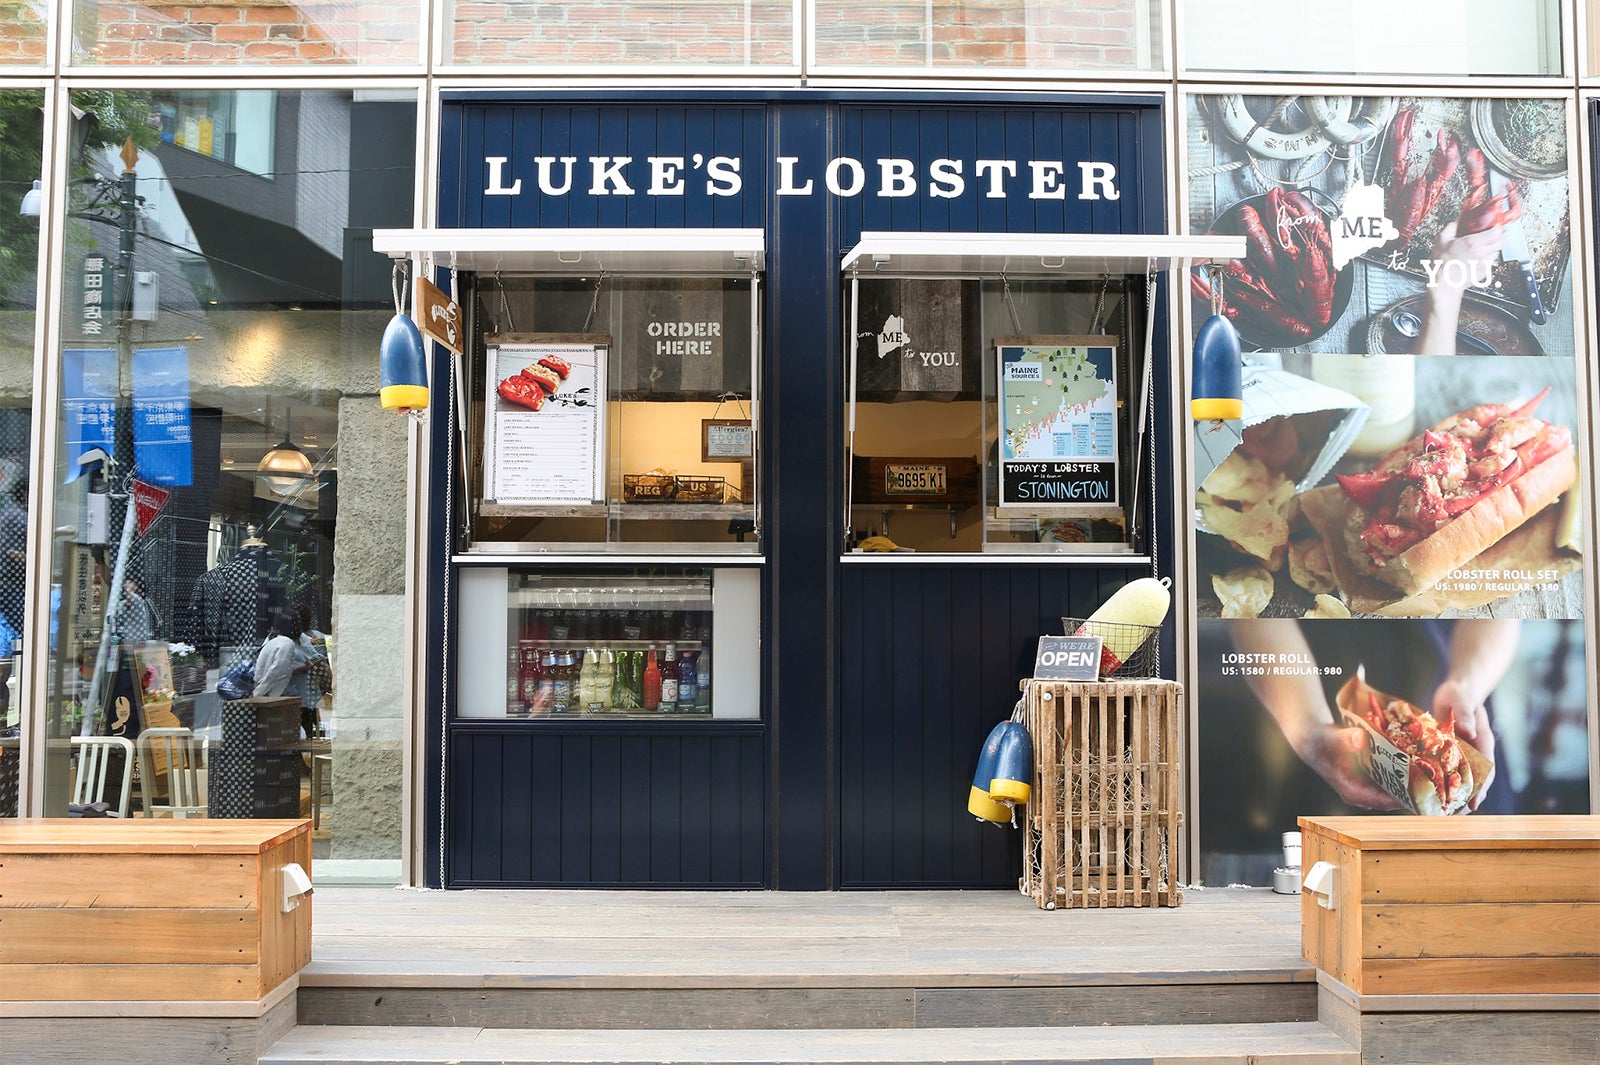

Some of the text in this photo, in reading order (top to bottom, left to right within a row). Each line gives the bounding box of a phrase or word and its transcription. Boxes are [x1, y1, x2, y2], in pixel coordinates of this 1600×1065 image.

[484, 153, 1121, 201] LUKE'S LOBSTER
[1276, 205, 1383, 249] from ME
[1387, 248, 1502, 288] to YOU.
[647, 322, 721, 337] ORDER
[882, 332, 903, 343] ME
[656, 340, 712, 355] HERE
[904, 347, 960, 367] to YOU.
[1006, 463, 1100, 473] TODAY'S LOBSTER
[690, 482, 707, 492] US
[898, 473, 943, 488] 9695 KI
[635, 486, 661, 495] REG
[1018, 480, 1109, 499] STONINGTON
[1447, 570, 1559, 580] LOBSTER ROLL SET
[1435, 583, 1451, 591] US:
[1453, 583, 1477, 591] 1980
[1485, 583, 1534, 591] REGULAR:
[1536, 583, 1559, 591] 1380
[1059, 642, 1095, 650] WE'RE
[1041, 651, 1095, 667] OPEN
[1222, 653, 1311, 664] LOBSTER ROLL
[1222, 667, 1239, 675] US:
[1240, 667, 1265, 675] 1580
[1273, 667, 1322, 675] REGULAR:
[1324, 667, 1343, 675] 980
